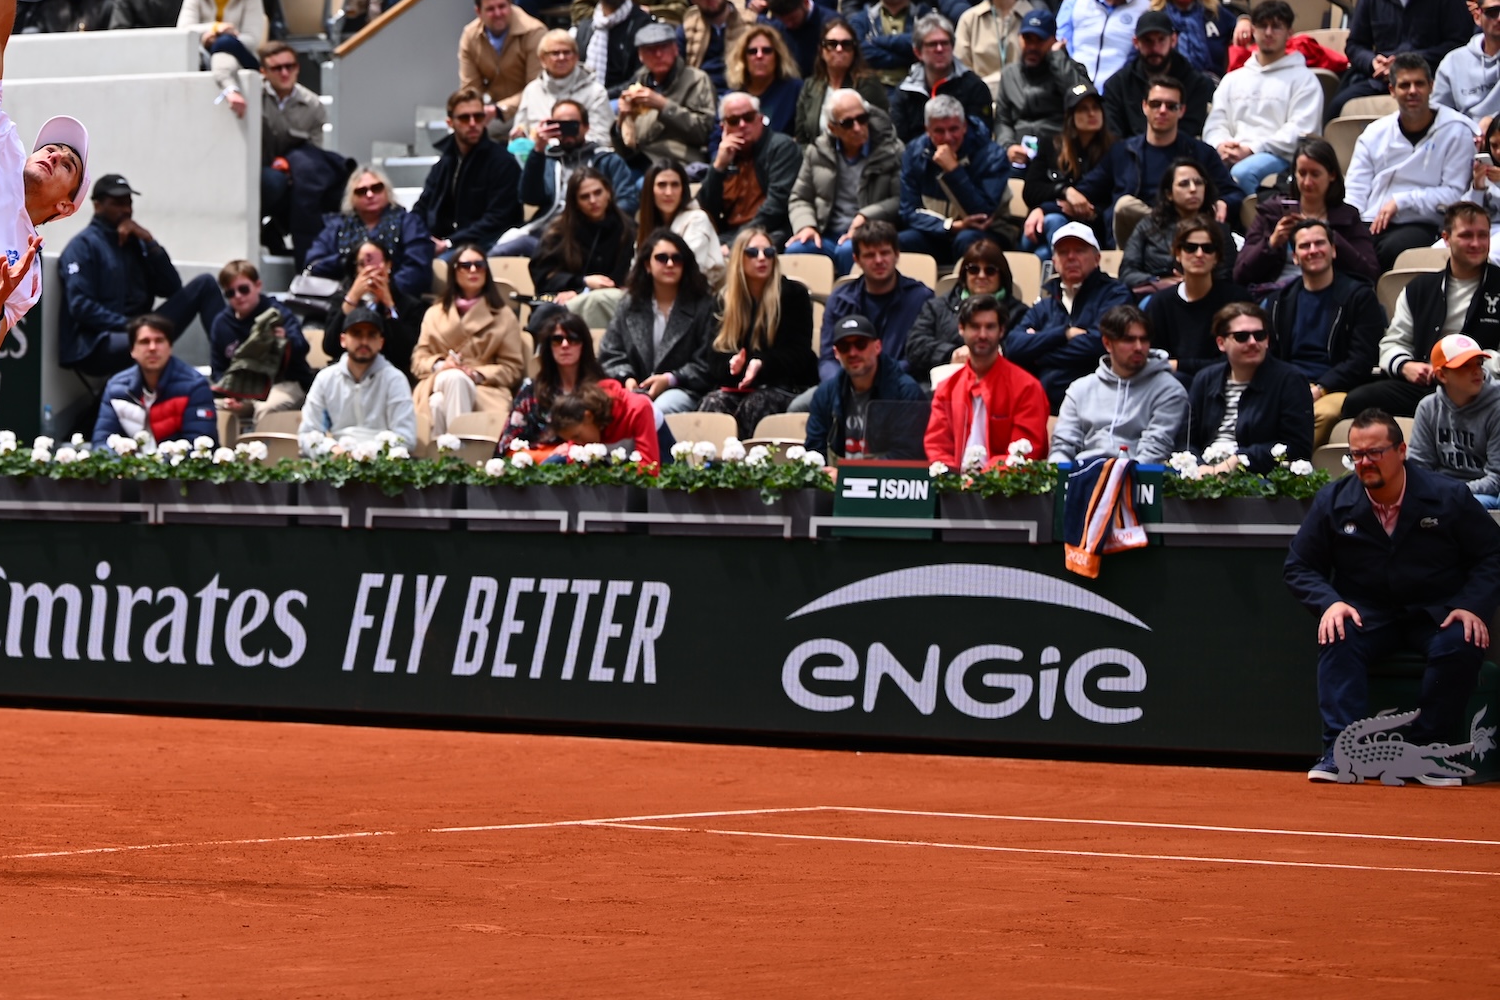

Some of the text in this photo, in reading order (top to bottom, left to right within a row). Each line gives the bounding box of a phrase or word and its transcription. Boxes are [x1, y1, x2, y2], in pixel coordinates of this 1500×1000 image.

[1205, 21, 1221, 38] A
[880, 478, 929, 500] ISDIN
[342, 573, 447, 674] FLY
[452, 576, 671, 684] BETTER
